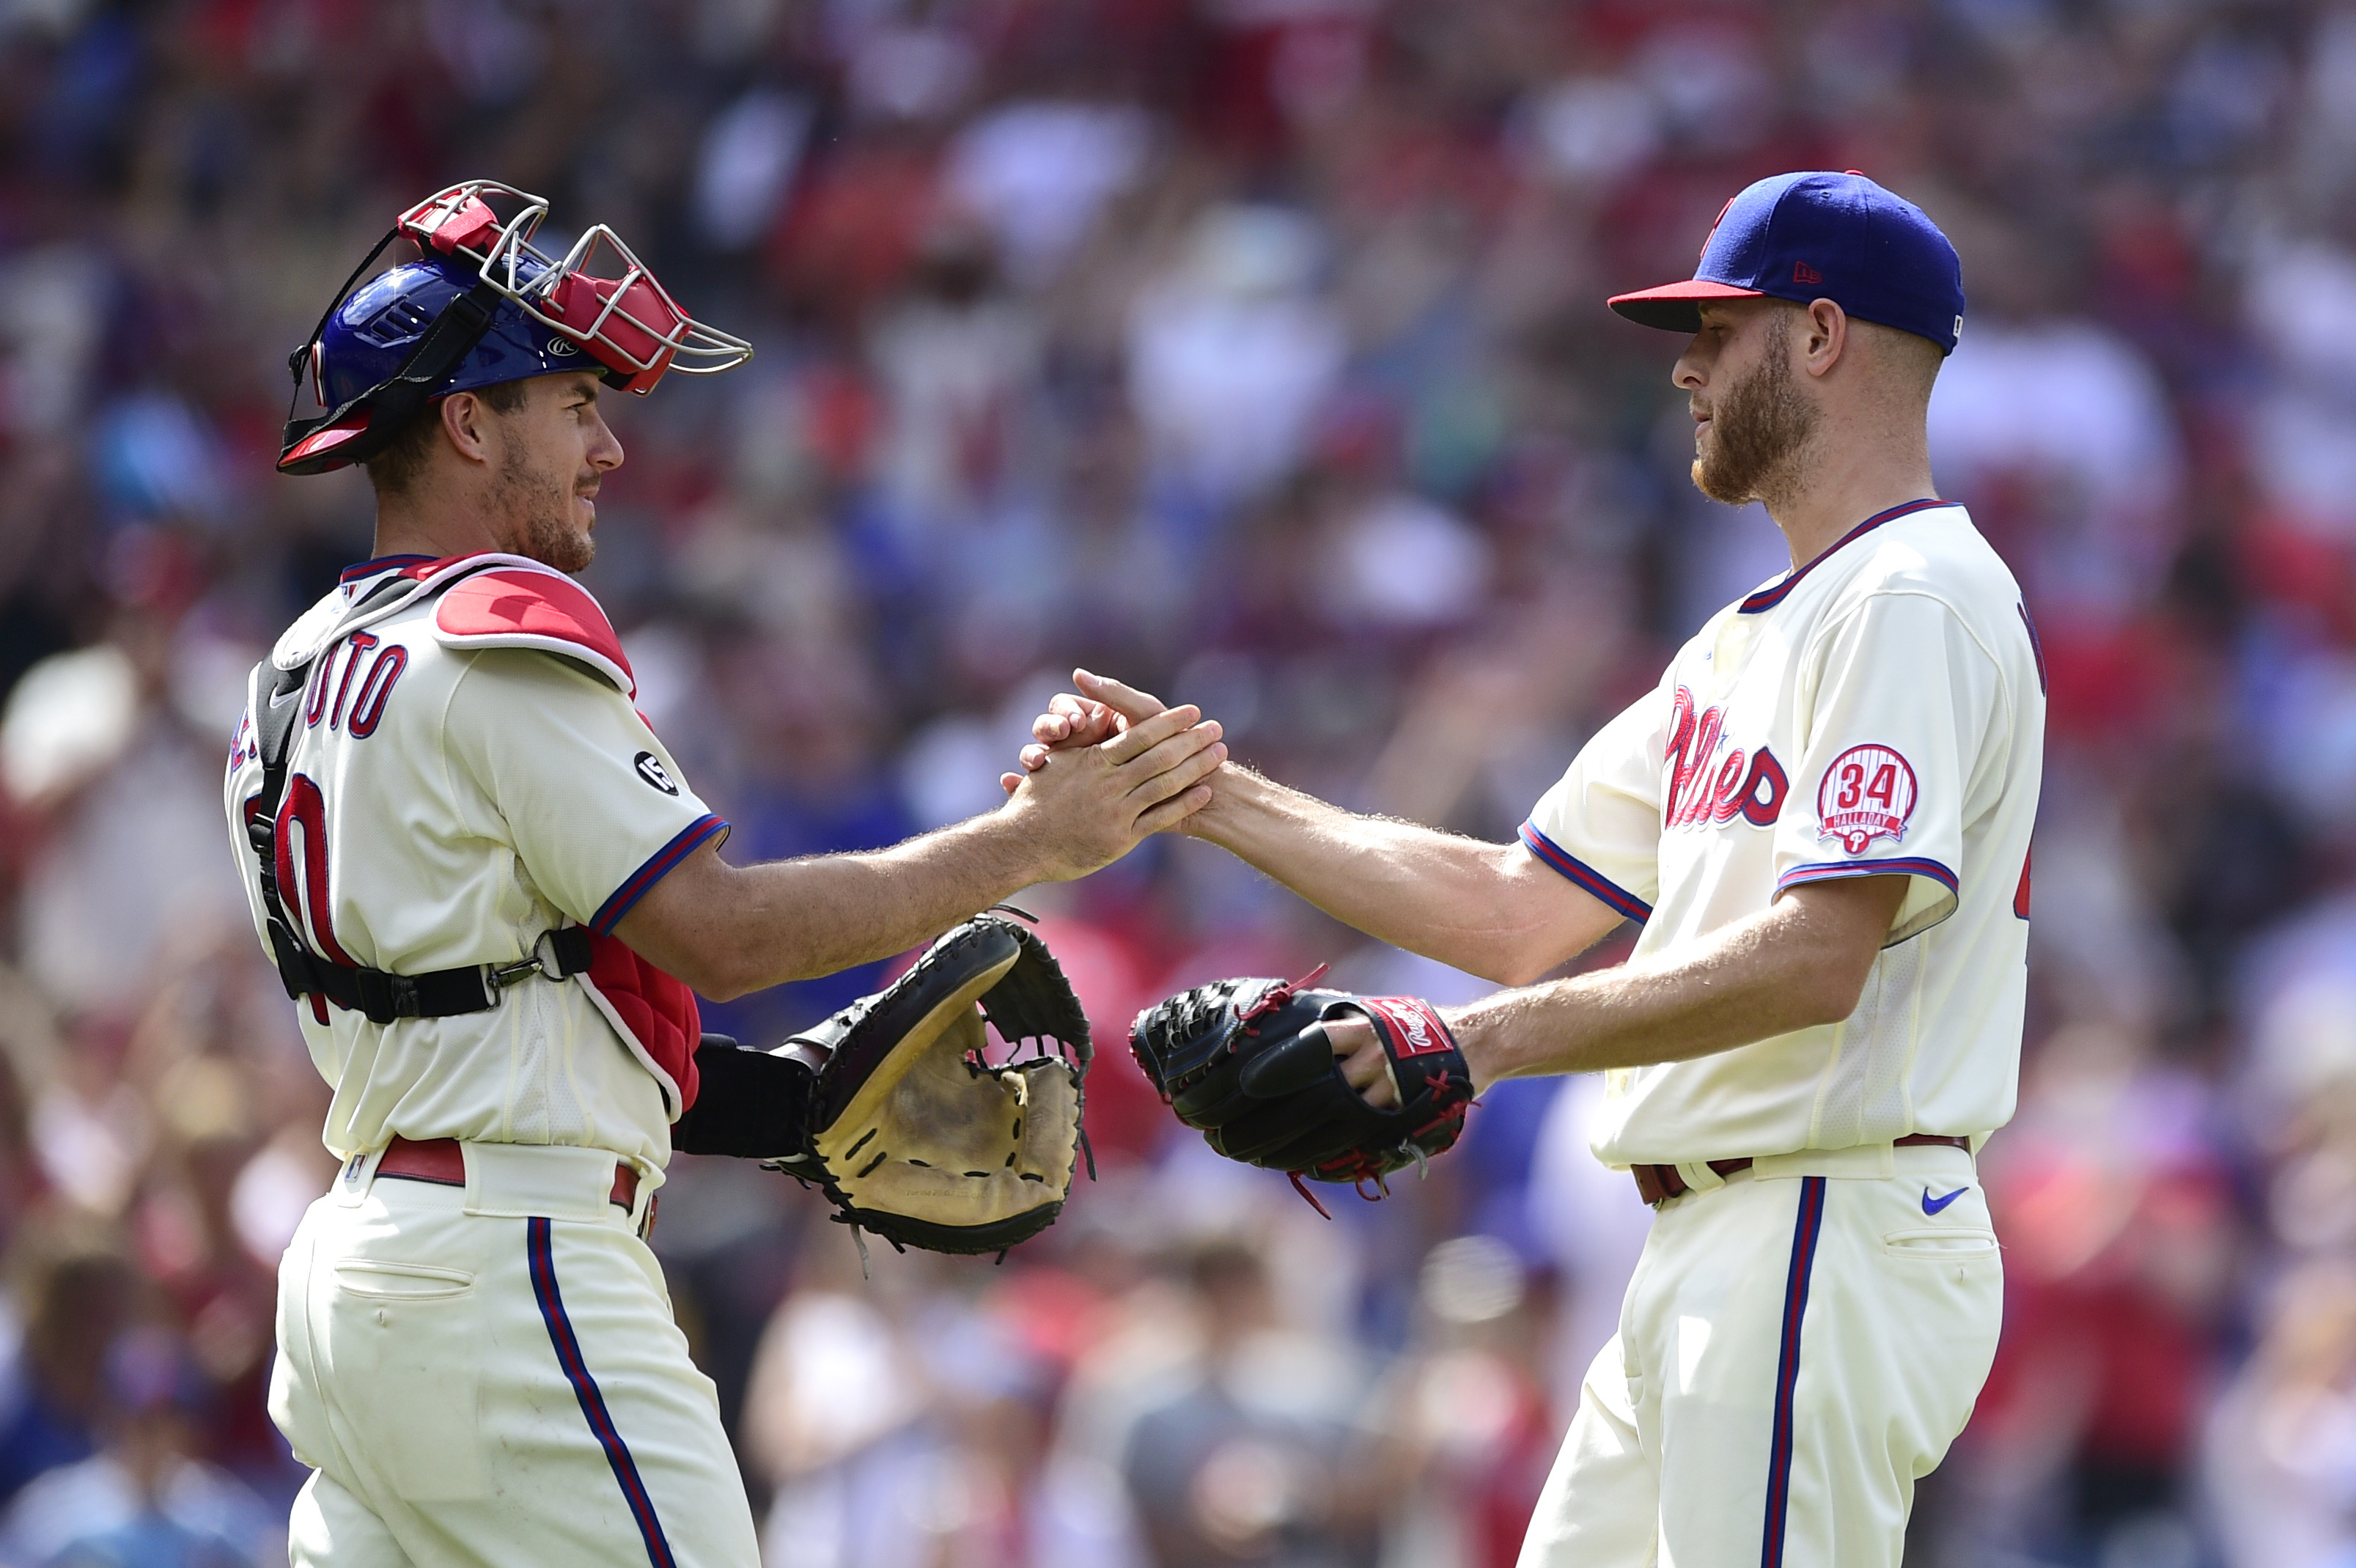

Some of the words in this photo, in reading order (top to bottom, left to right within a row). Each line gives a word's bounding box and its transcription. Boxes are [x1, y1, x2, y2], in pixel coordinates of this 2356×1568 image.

[638, 756, 674, 791] 15
[1838, 763, 1896, 809] 34
[1833, 812, 1890, 828] HALLADAY
[1849, 832, 1866, 852] P
